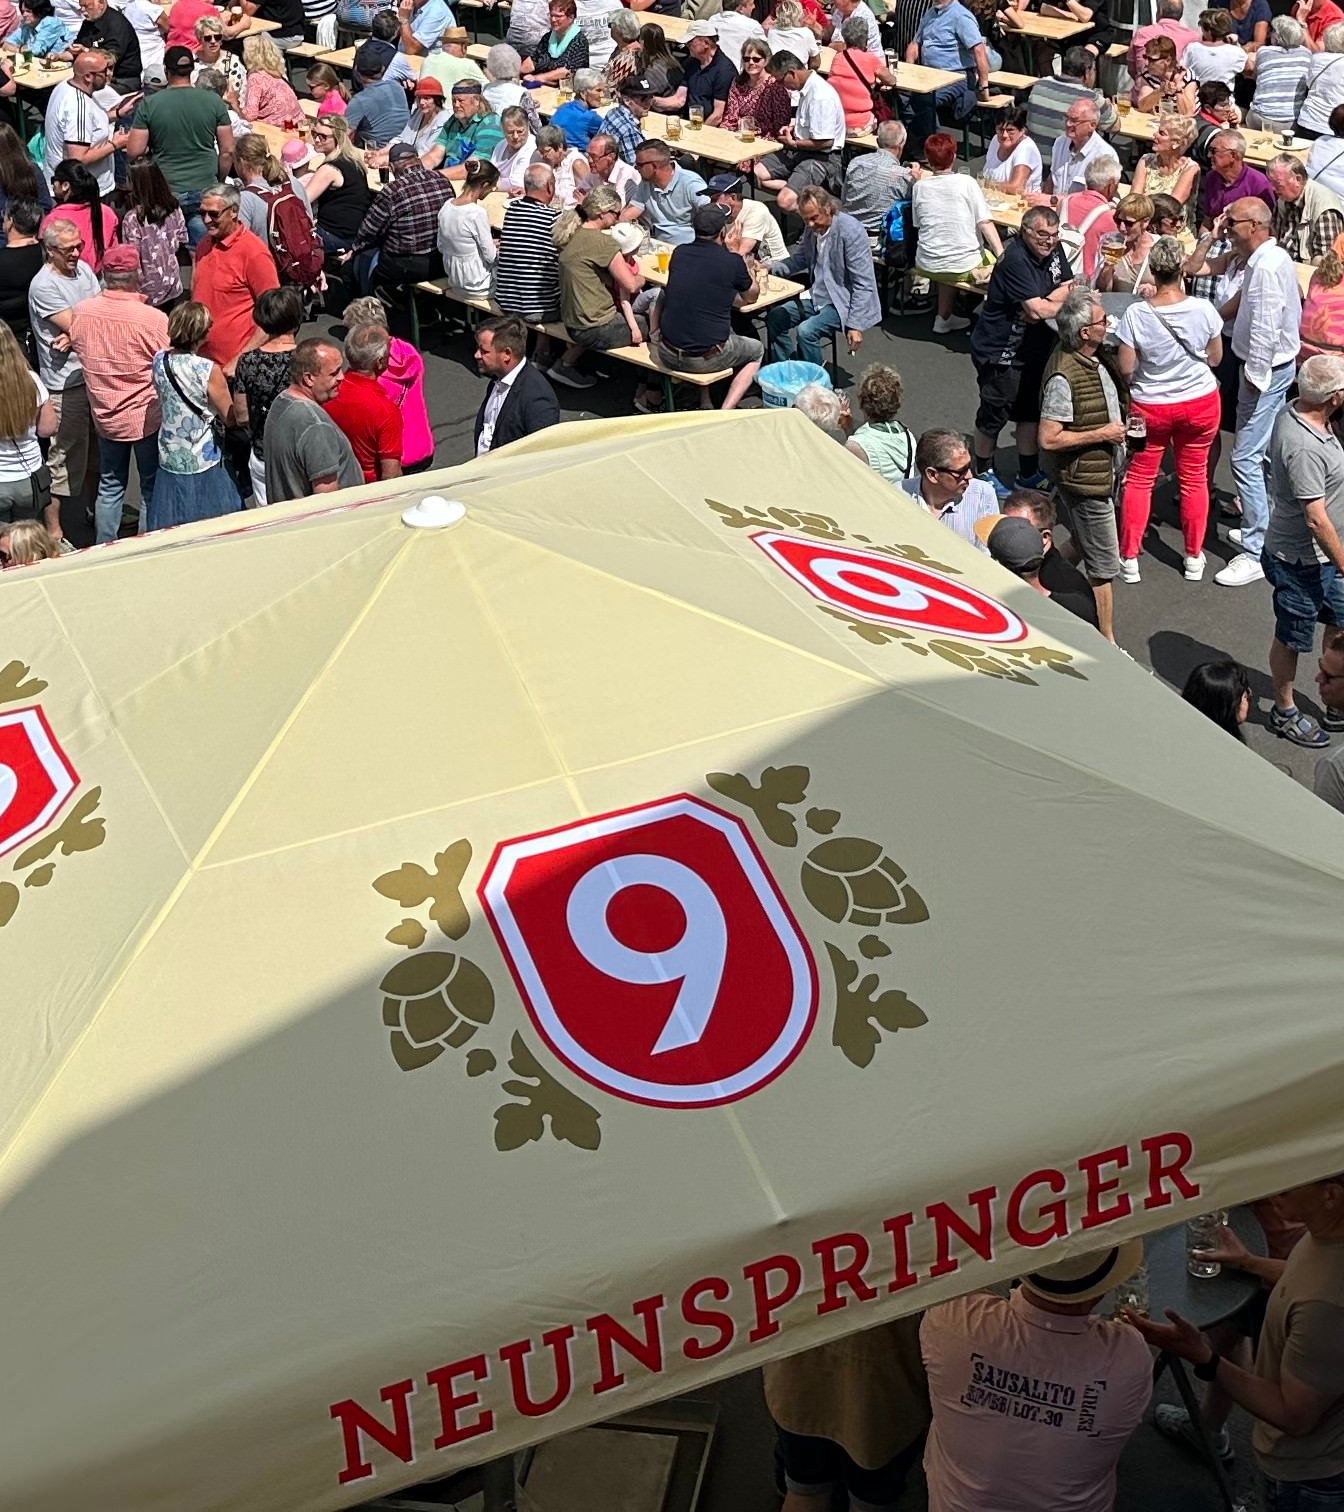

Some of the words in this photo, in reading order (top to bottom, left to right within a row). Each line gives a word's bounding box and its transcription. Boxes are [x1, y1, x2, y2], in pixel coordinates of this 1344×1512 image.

[809, 556, 986, 620] 9
[566, 853, 728, 1056] 9
[328, 1131, 1201, 1486] NEUNSPRINGER
[972, 1361, 1075, 1406] SAUSALITO
[1077, 1384, 1099, 1432] ESPRIT
